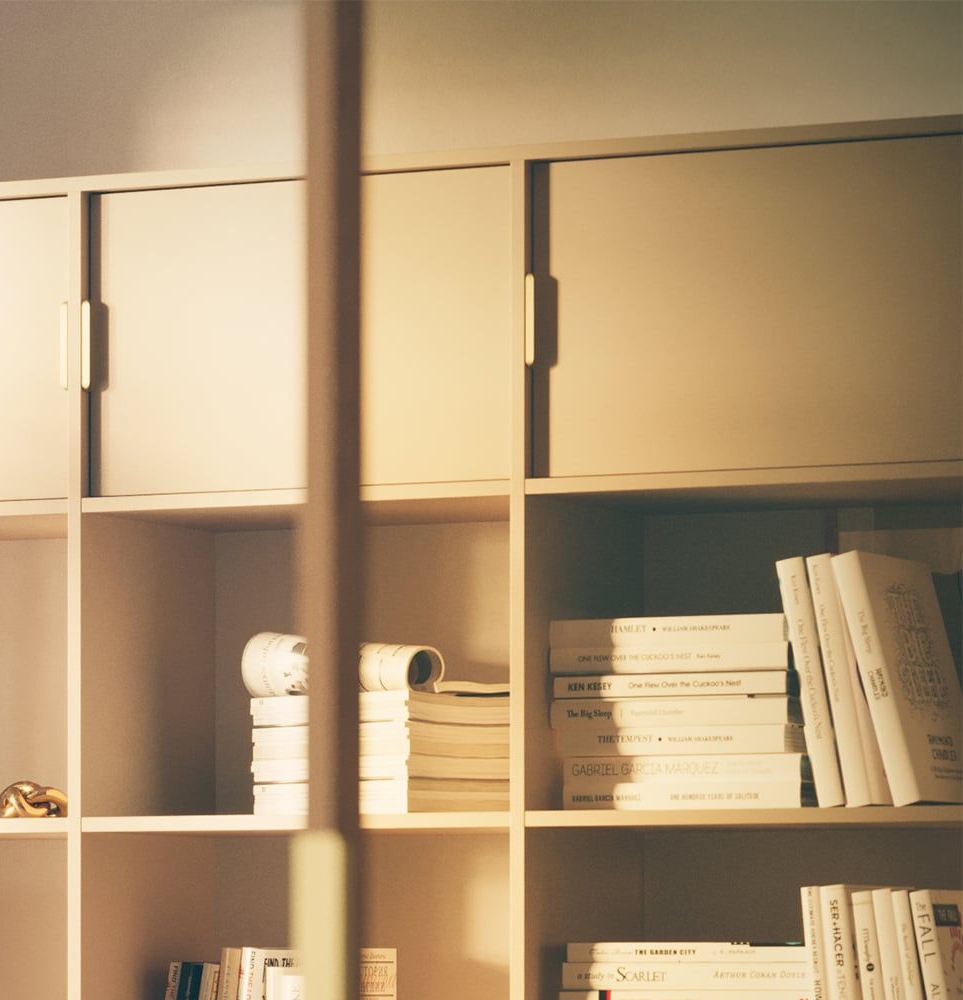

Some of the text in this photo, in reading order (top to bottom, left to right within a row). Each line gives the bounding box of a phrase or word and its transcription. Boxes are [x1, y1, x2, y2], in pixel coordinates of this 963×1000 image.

[610, 624, 647, 634] HAMLET
[578, 655, 592, 663] ONE
[593, 654, 610, 663] FLEW
[610, 654, 627, 662] OVER
[627, 654, 640, 662] THE
[675, 652, 691, 660] NEST
[567, 679, 742, 692] KEN KESEY One Flew Over the Cuckoo's Nest
[566, 709, 580, 719] The
[580, 709, 593, 720] Big
[593, 709, 612, 720] Sleep
[597, 735, 614, 744] THE
[613, 734, 652, 744] TEMPEST
[571, 763, 619, 777] GABRIEL
[829, 898, 839, 920] SER
[917, 913, 936, 964] FALL
[634, 948, 648, 956] THE
[649, 948, 678, 956] GARDEN
[678, 948, 697, 956] CITY
[831, 926, 845, 968] HACER
[264, 957, 279, 967] FIND
[583, 971, 605, 984] study
[615, 966, 668, 983] SCARLET
[712, 970, 747, 980] ARTHUR
[779, 970, 806, 980] DOYLE
